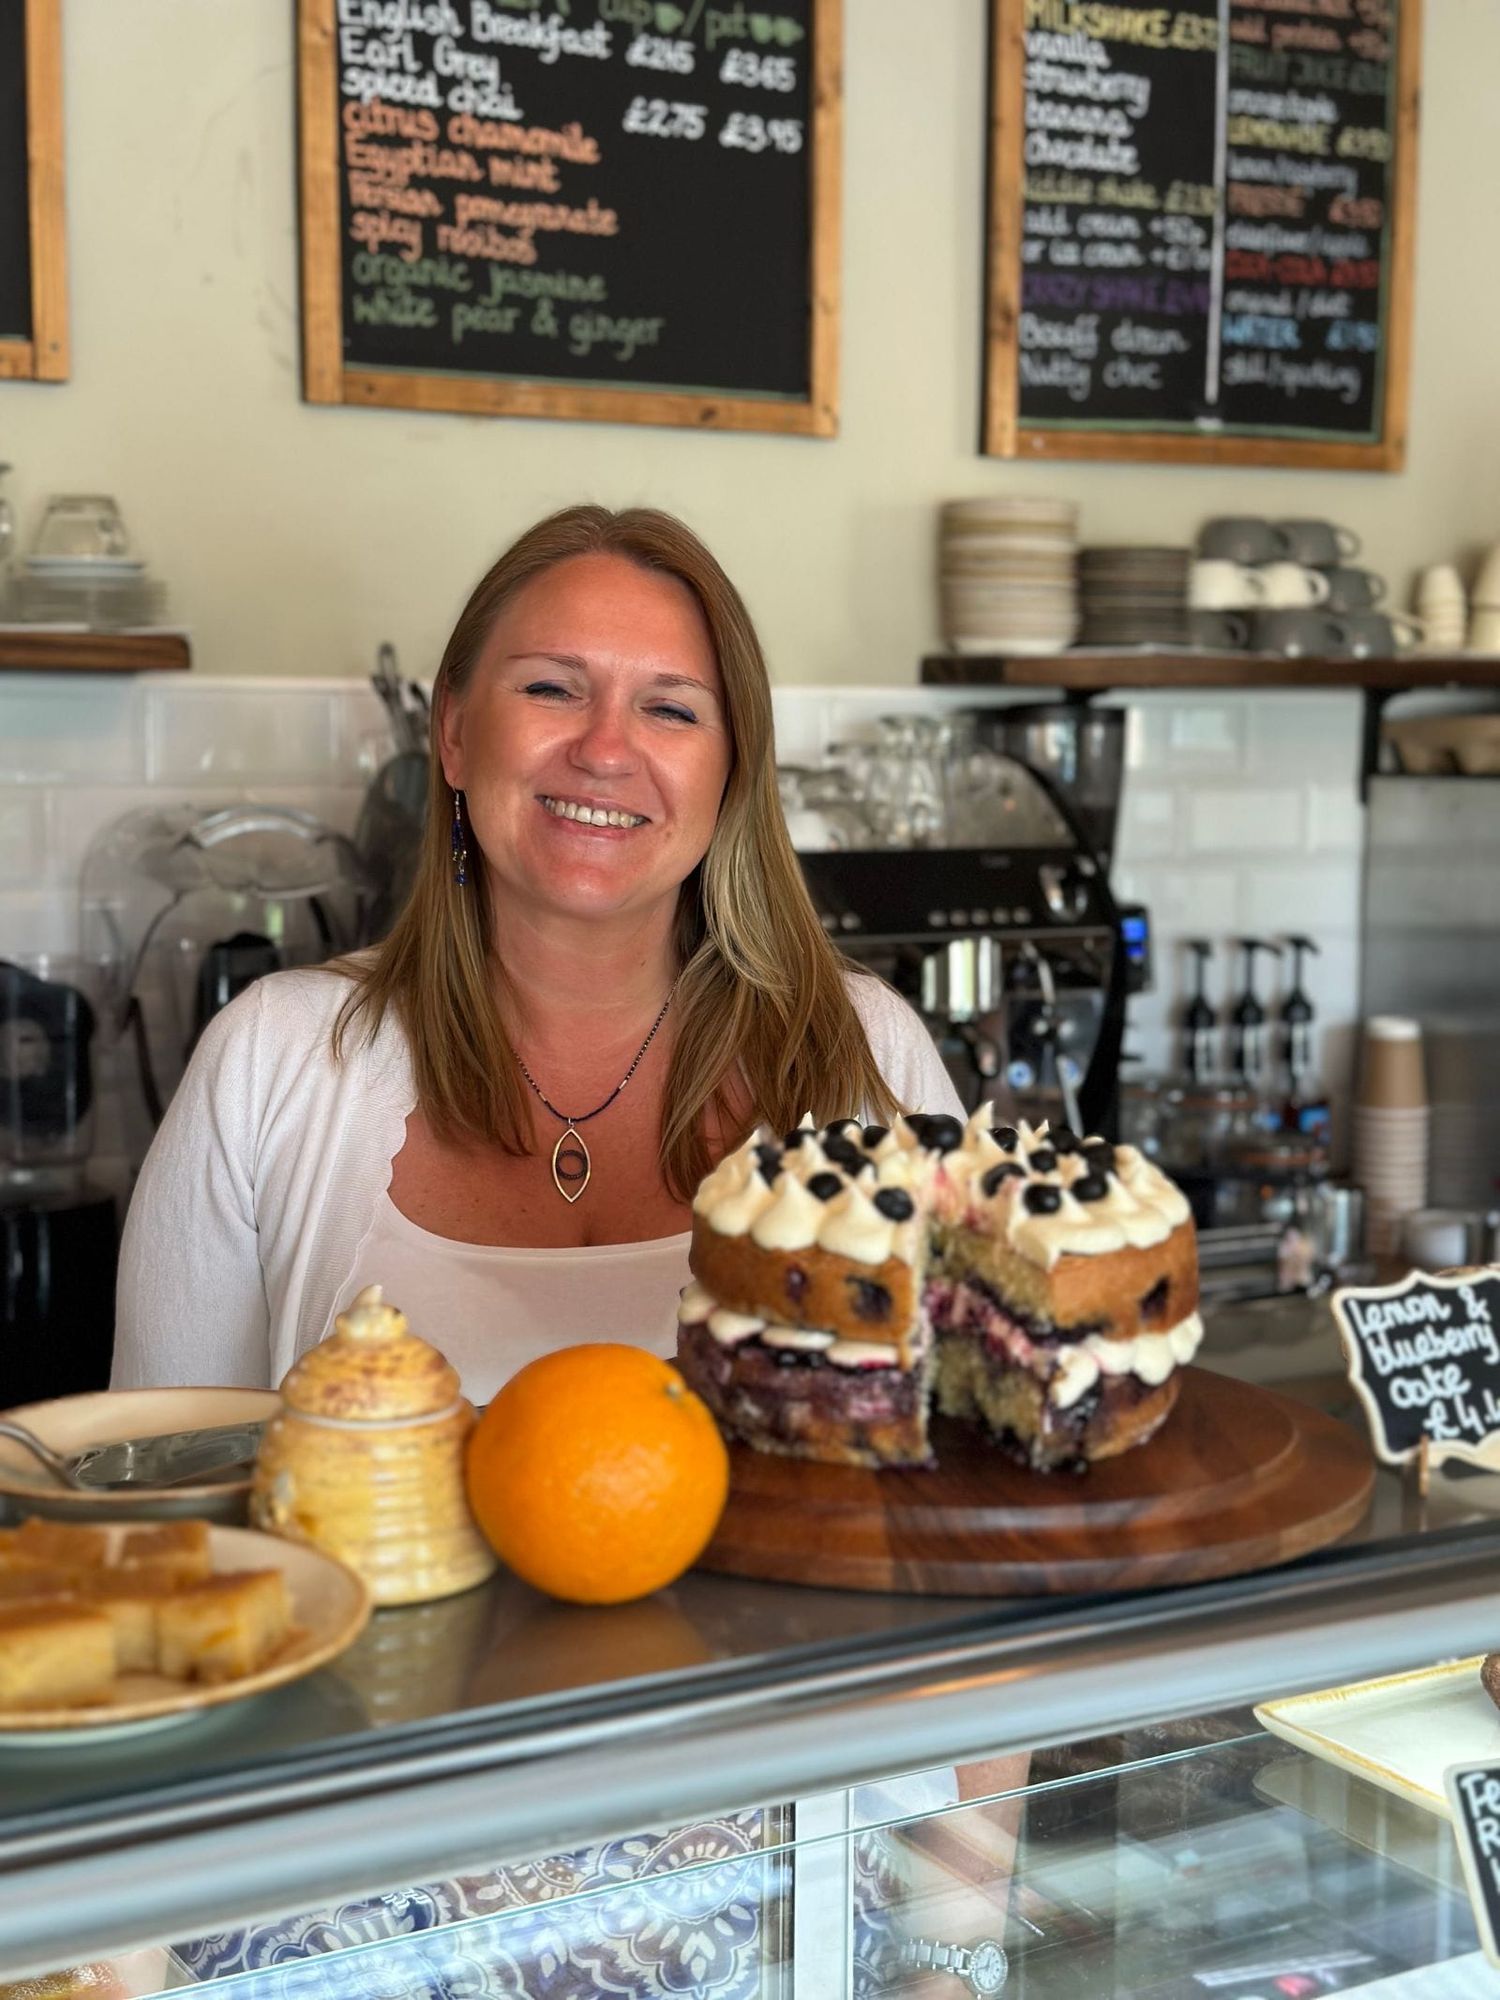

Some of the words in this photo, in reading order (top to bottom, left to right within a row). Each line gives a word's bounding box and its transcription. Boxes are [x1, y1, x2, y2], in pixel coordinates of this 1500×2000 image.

[339, 0, 465, 42] English
[470, 0, 613, 64] Breakfast
[339, 26, 422, 72] Earl
[433, 35, 499, 95] Grey
[487, 156, 561, 193] mint
[452, 303, 521, 344] pear
[531, 298, 558, 338] &
[568, 311, 665, 361] ginger
[1457, 1284, 1492, 1322] &
[1366, 1321, 1500, 1376] blueberry
[1389, 1362, 1472, 1410] cake
